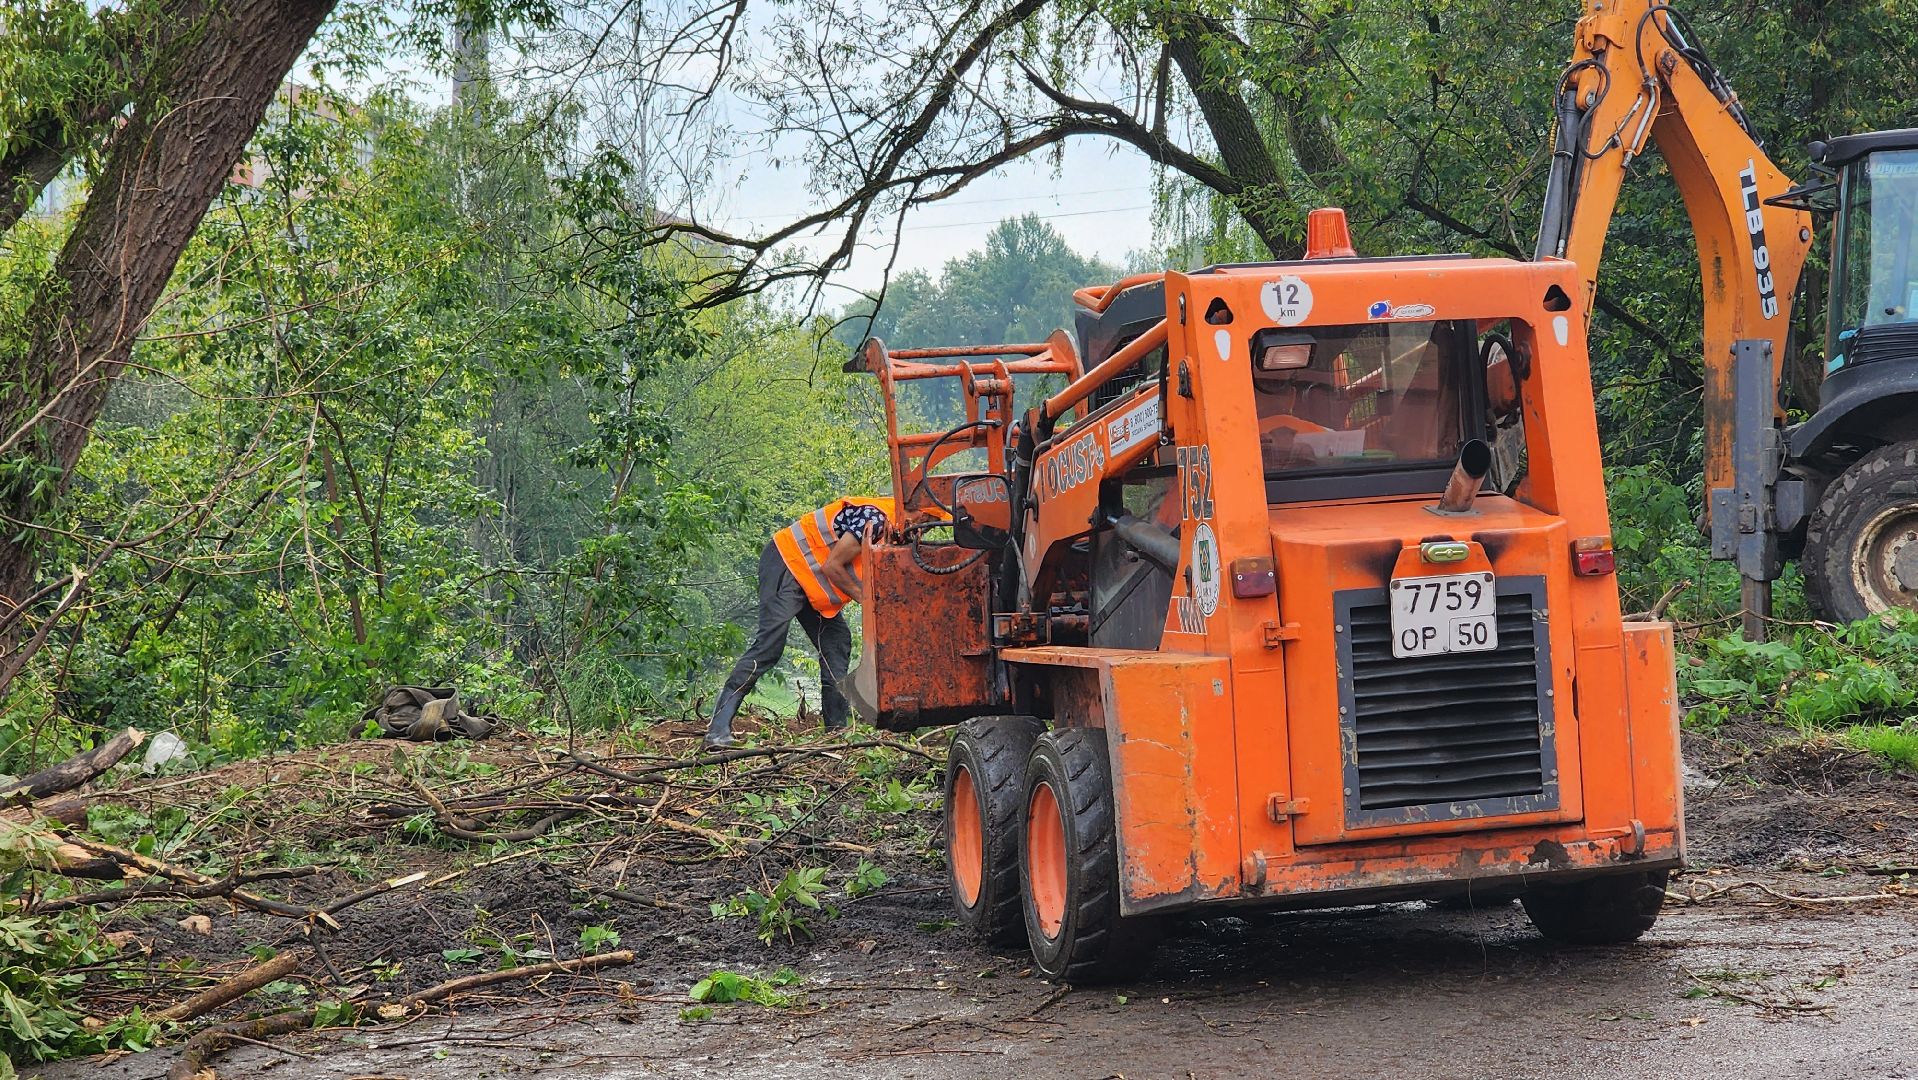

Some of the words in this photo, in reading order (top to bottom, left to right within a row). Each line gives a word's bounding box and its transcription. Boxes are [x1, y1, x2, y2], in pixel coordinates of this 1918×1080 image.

[1739, 158, 1764, 235] TLB
[1753, 245, 1780, 320] 935
[1272, 284, 1300, 305] 12
[1280, 307, 1296, 317] km
[1176, 444, 1214, 520] 752
[1404, 580, 1482, 614] 7759
[1401, 626, 1437, 651] OP
[1458, 622, 1488, 646] 50
